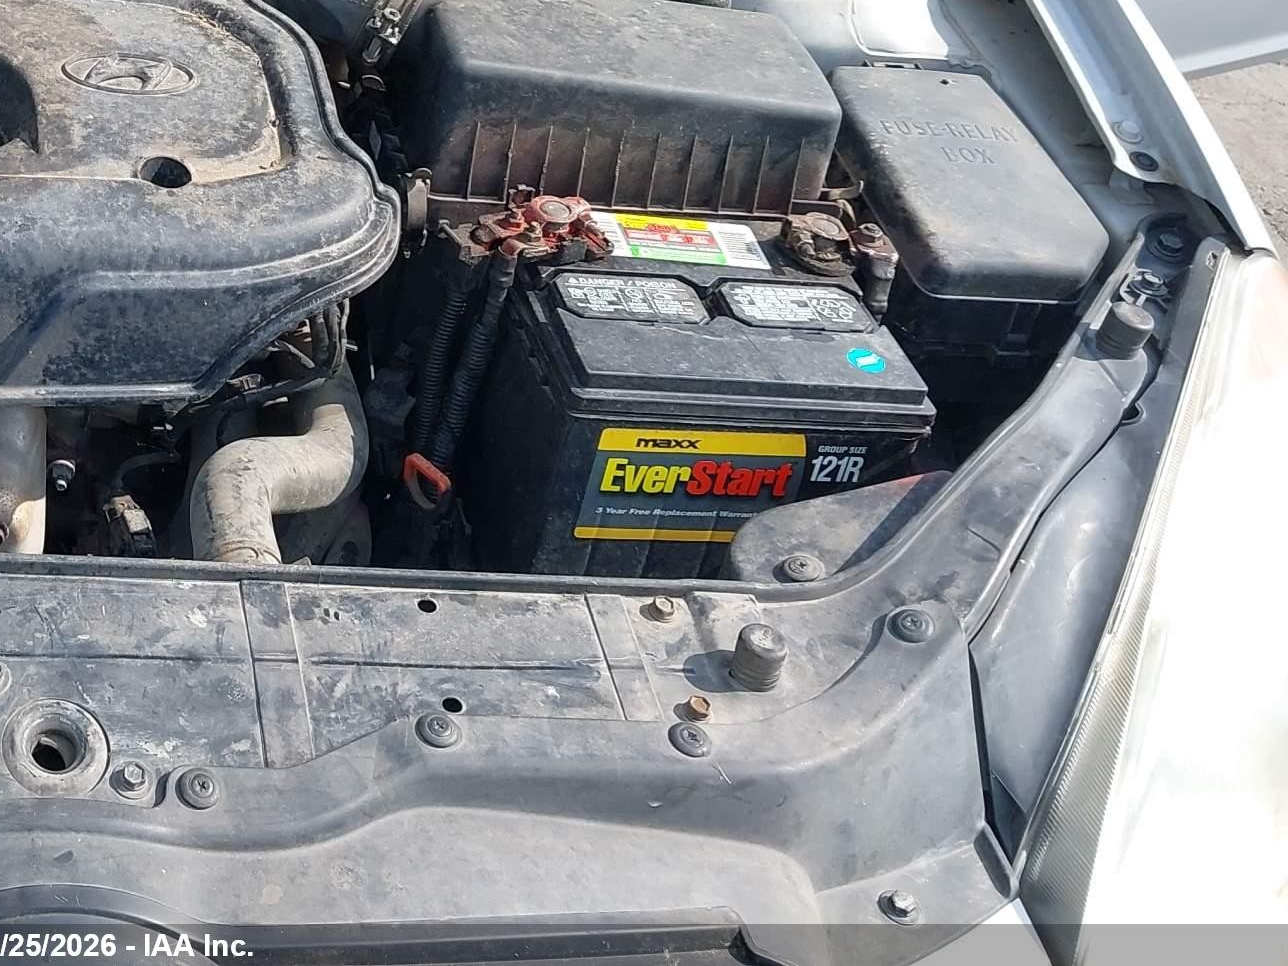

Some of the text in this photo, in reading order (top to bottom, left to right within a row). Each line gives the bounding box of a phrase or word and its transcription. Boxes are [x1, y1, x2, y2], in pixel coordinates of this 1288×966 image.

[879, 120, 1019, 142] FUSE-RELAY
[940, 146, 996, 164] BOX
[578, 277, 624, 287] DANGER
[635, 279, 677, 289] POISON
[635, 437, 702, 450] maxx
[818, 445, 868, 454] GROUP SIZE
[599, 456, 793, 497] EverStart
[810, 455, 864, 483] 121R
[605, 507, 627, 515] Year
[629, 508, 651, 516] Free
[652, 509, 718, 518] Replacement
